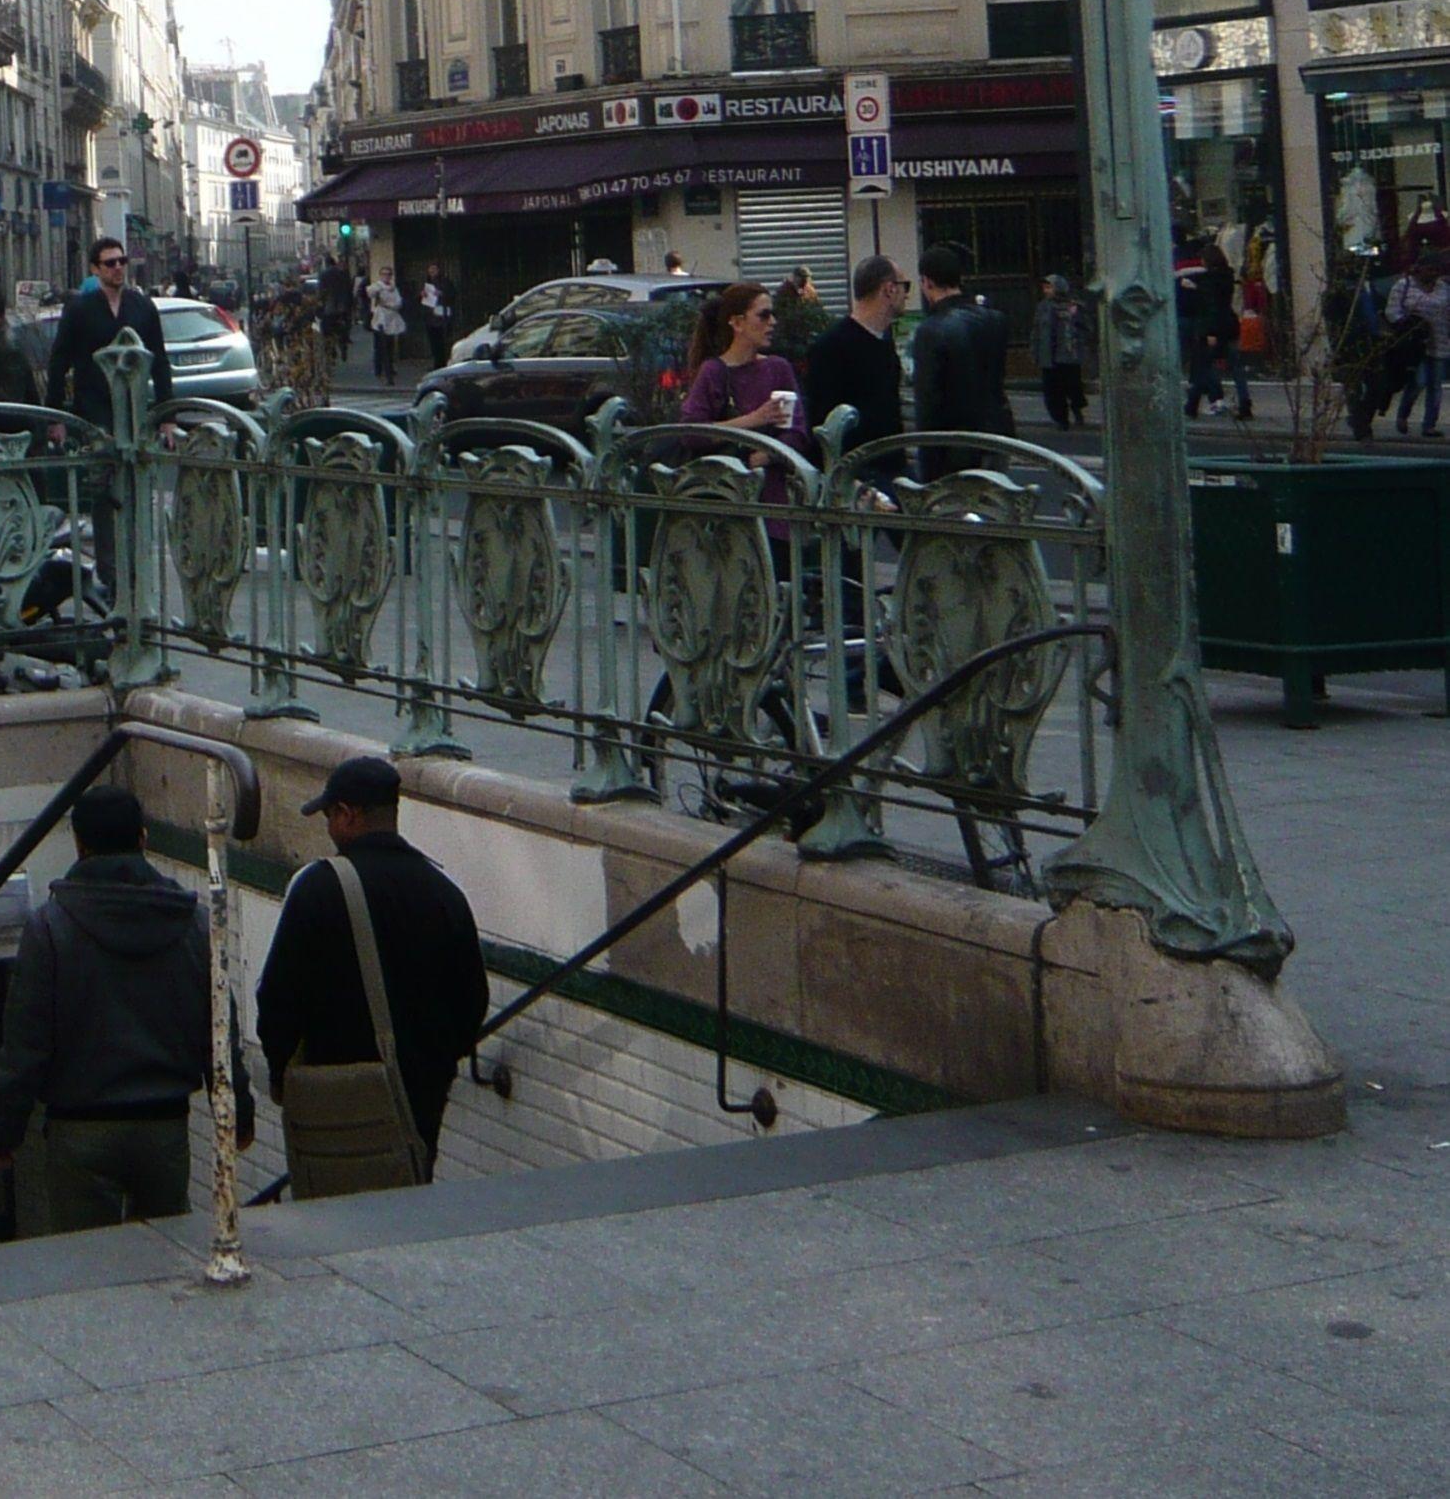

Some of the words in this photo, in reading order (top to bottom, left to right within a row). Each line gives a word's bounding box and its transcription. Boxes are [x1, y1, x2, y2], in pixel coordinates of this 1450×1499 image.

[854, 79, 877, 89] ZONE
[724, 93, 845, 118] RESTAURA
[861, 103, 875, 115] 30
[534, 111, 590, 134] JAPONAIS
[350, 132, 414, 155] RESTAURANT
[892, 158, 1016, 179] KUSHIYAMA
[610, 179, 628, 193] 47
[631, 176, 650, 191] 70
[653, 172, 672, 187] 45
[673, 169, 691, 184] 67
[397, 197, 465, 216] FUKUSHIMA
[521, 192, 574, 211] JAPONAI
